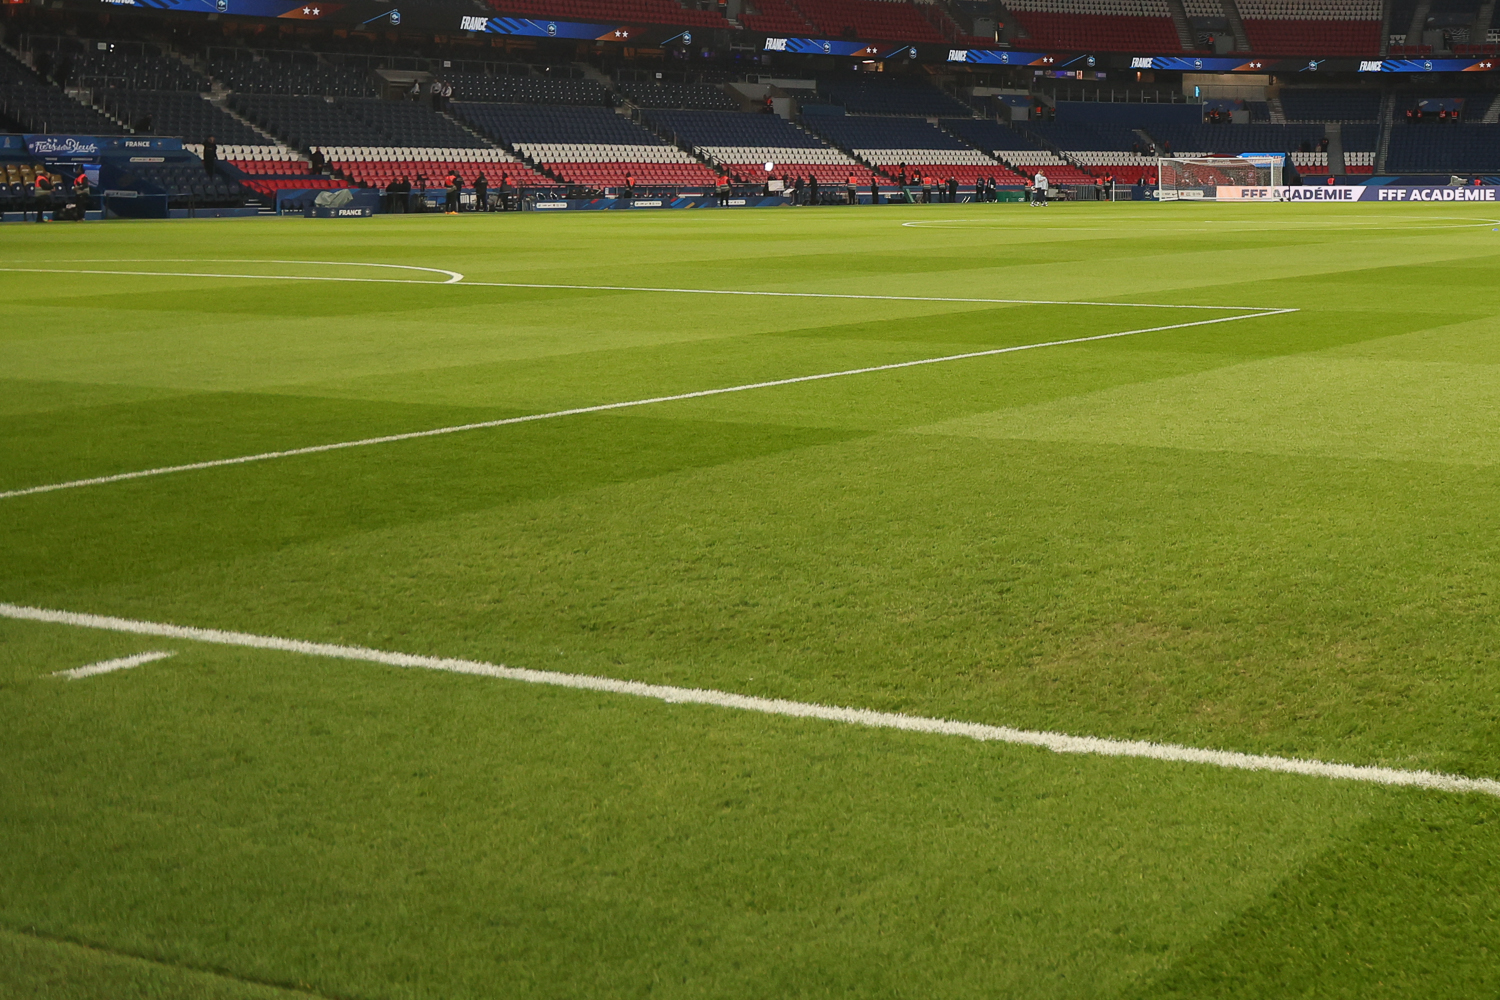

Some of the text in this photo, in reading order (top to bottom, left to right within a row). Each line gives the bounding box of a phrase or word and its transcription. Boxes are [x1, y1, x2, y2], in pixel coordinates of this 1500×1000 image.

[460, 16, 488, 31] FRANCE
[764, 38, 787, 51] FRANCE
[947, 49, 967, 61] FRANCE
[1131, 57, 1153, 68] FRANCE
[1359, 61, 1382, 71] FRANCE
[1241, 187, 1352, 200] FFF ACADÉMIE
[1378, 187, 1495, 201] FFF ACADÉMIE
